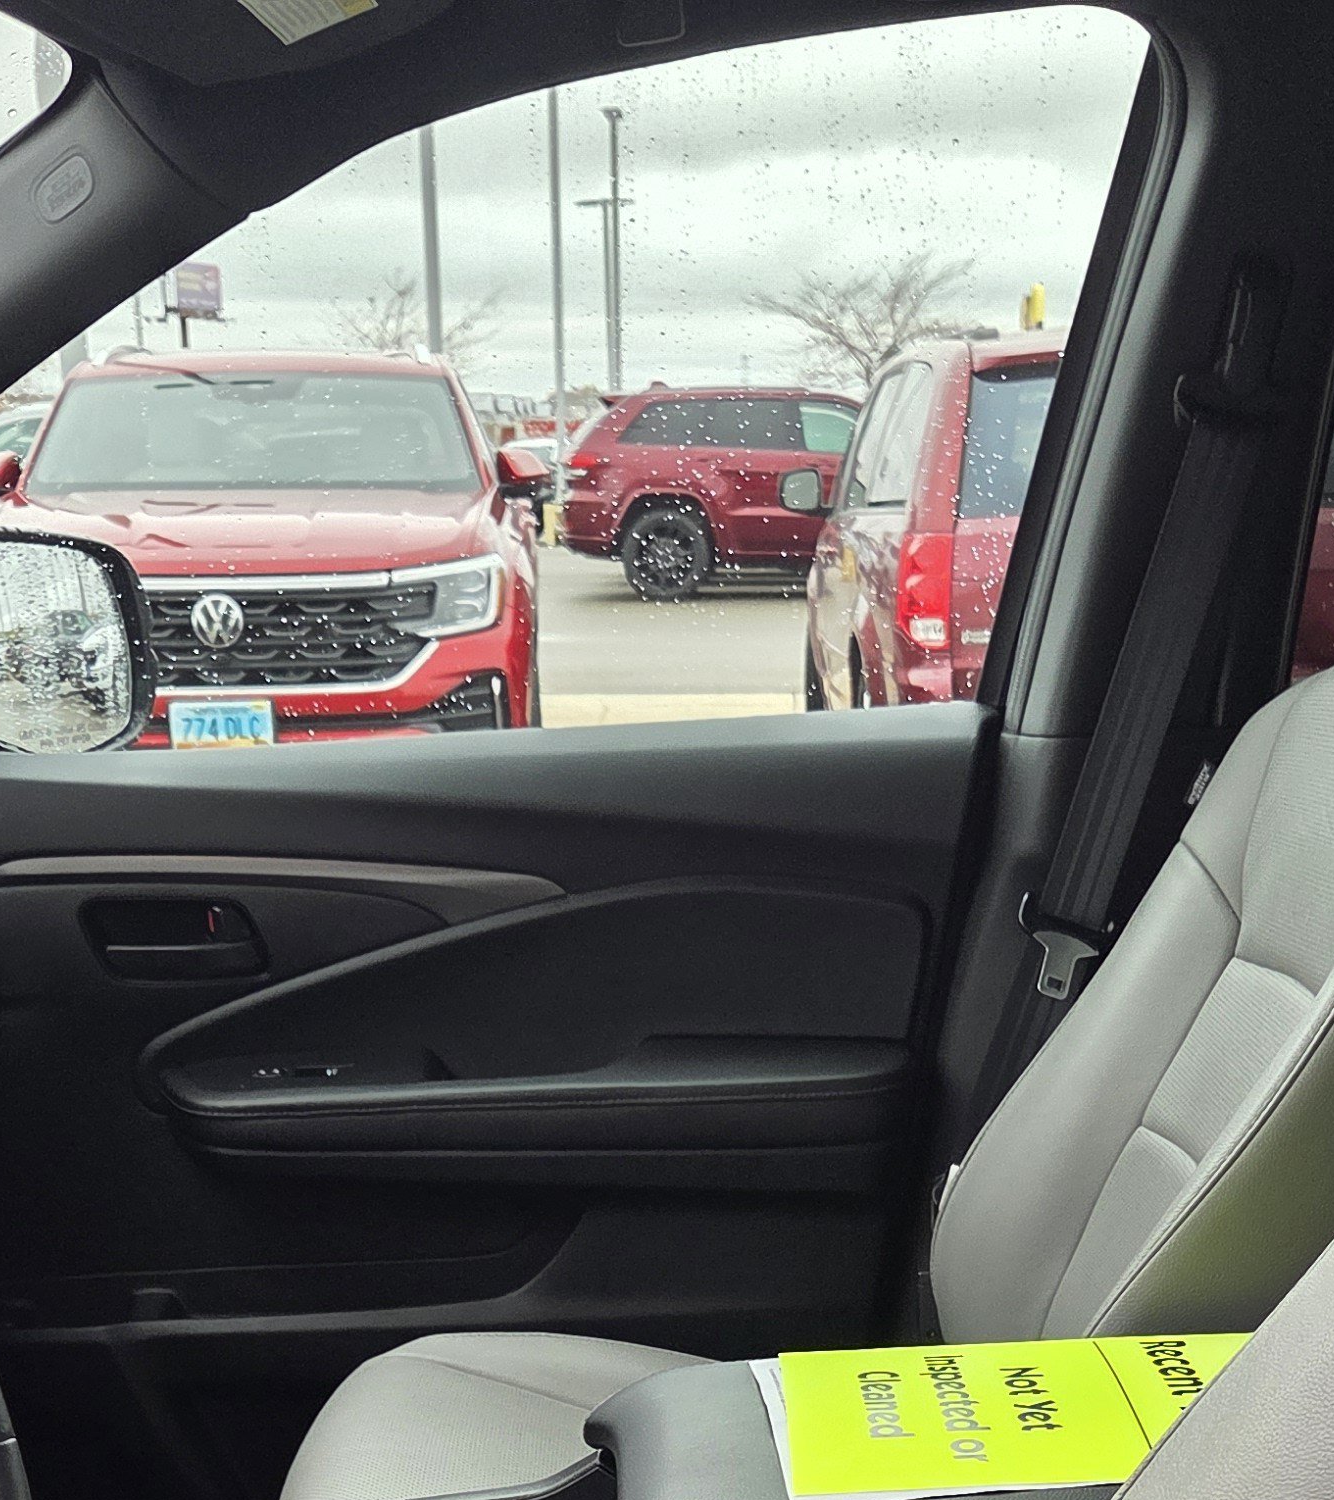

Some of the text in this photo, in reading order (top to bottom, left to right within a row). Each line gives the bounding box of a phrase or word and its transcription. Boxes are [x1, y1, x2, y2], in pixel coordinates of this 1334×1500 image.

[181, 717, 219, 740] 774
[857, 1371, 915, 1438] Cleaned
[919, 1354, 991, 1462] Inspected or
[999, 1366, 1064, 1431] Not Yet
